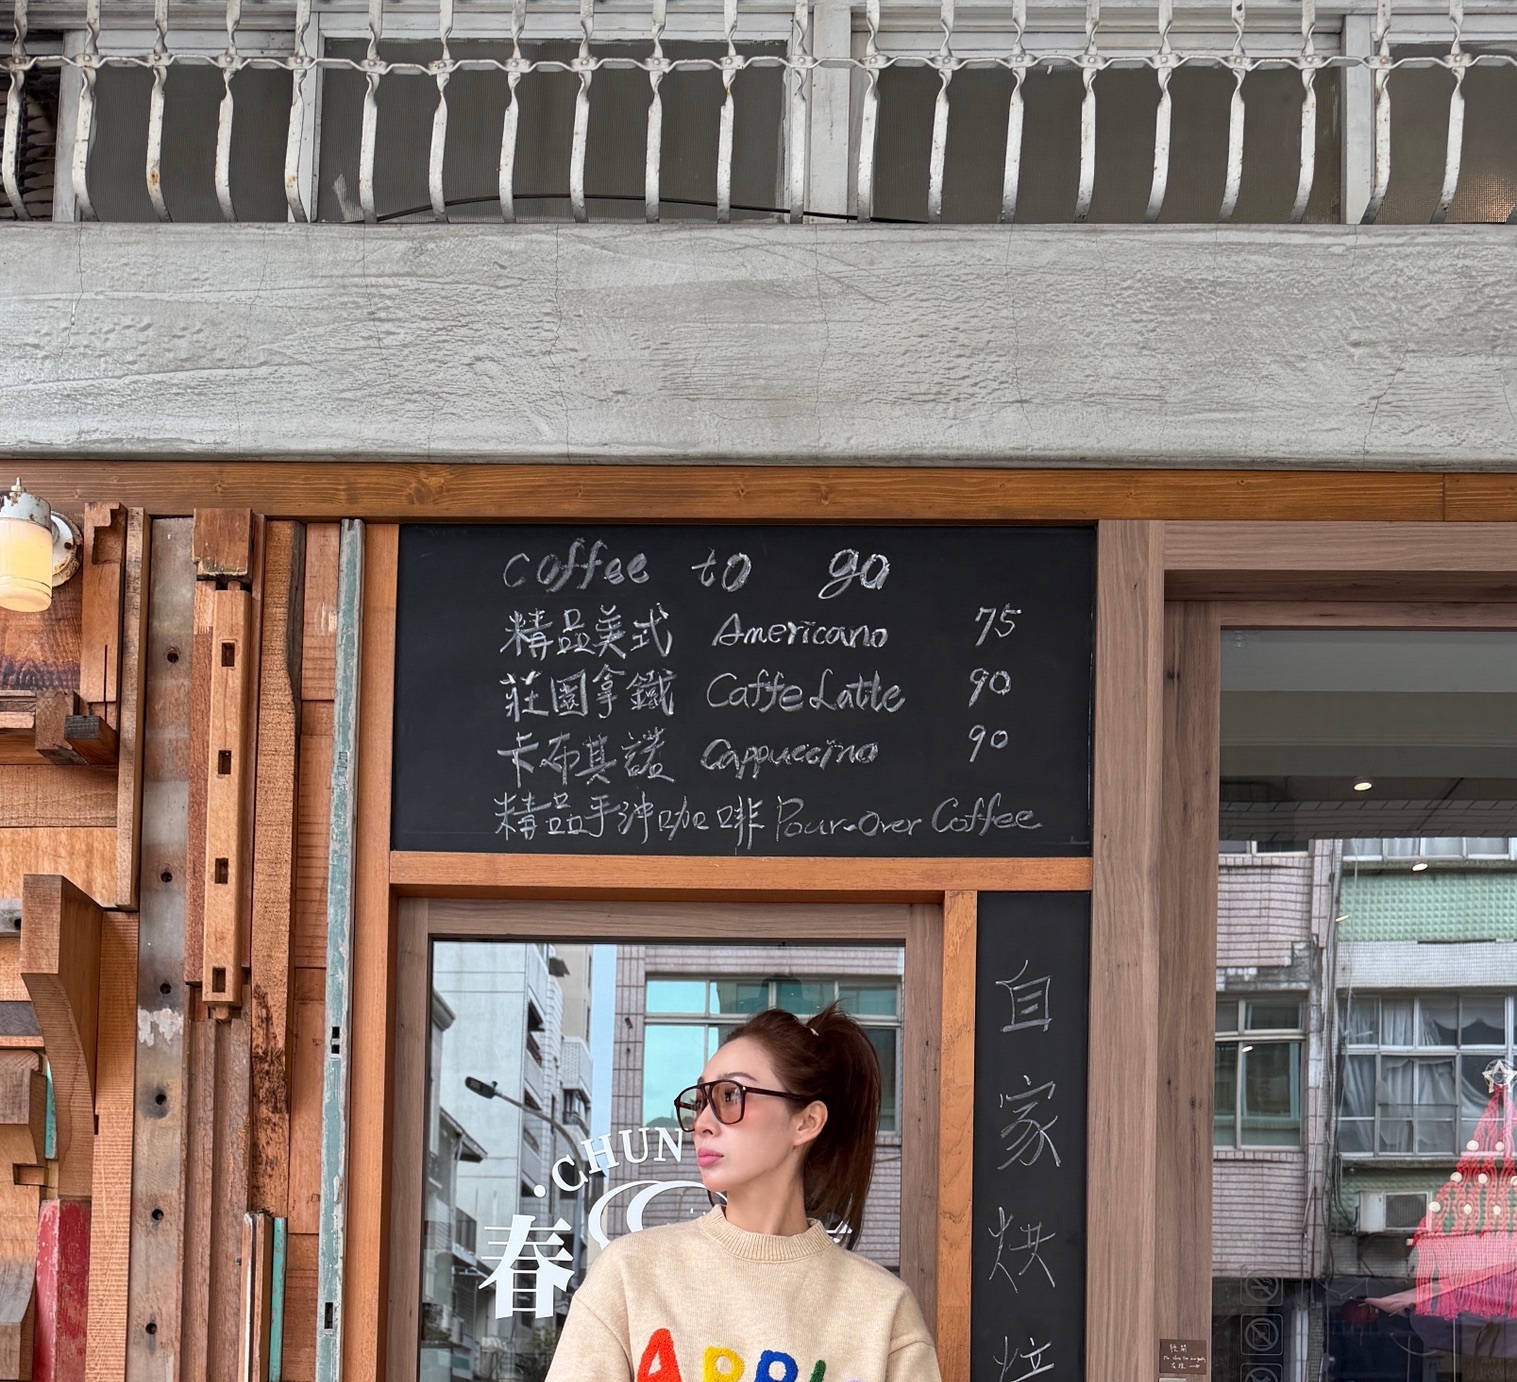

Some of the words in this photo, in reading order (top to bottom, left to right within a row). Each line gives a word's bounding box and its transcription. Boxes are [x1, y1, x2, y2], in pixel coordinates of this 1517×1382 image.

[691, 547, 752, 593] to
[818, 548, 891, 599] go
[500, 603, 674, 661] 精品美式
[711, 613, 889, 648] Americano
[974, 603, 1022, 647] 75
[499, 663, 678, 722] 莊園拿鐵
[968, 667, 1012, 707] 90
[968, 724, 1009, 762] 90
[931, 792, 1043, 837] Coffee
[551, 1128, 684, 1193] CHUN
[478, 1214, 575, 1319] 春
